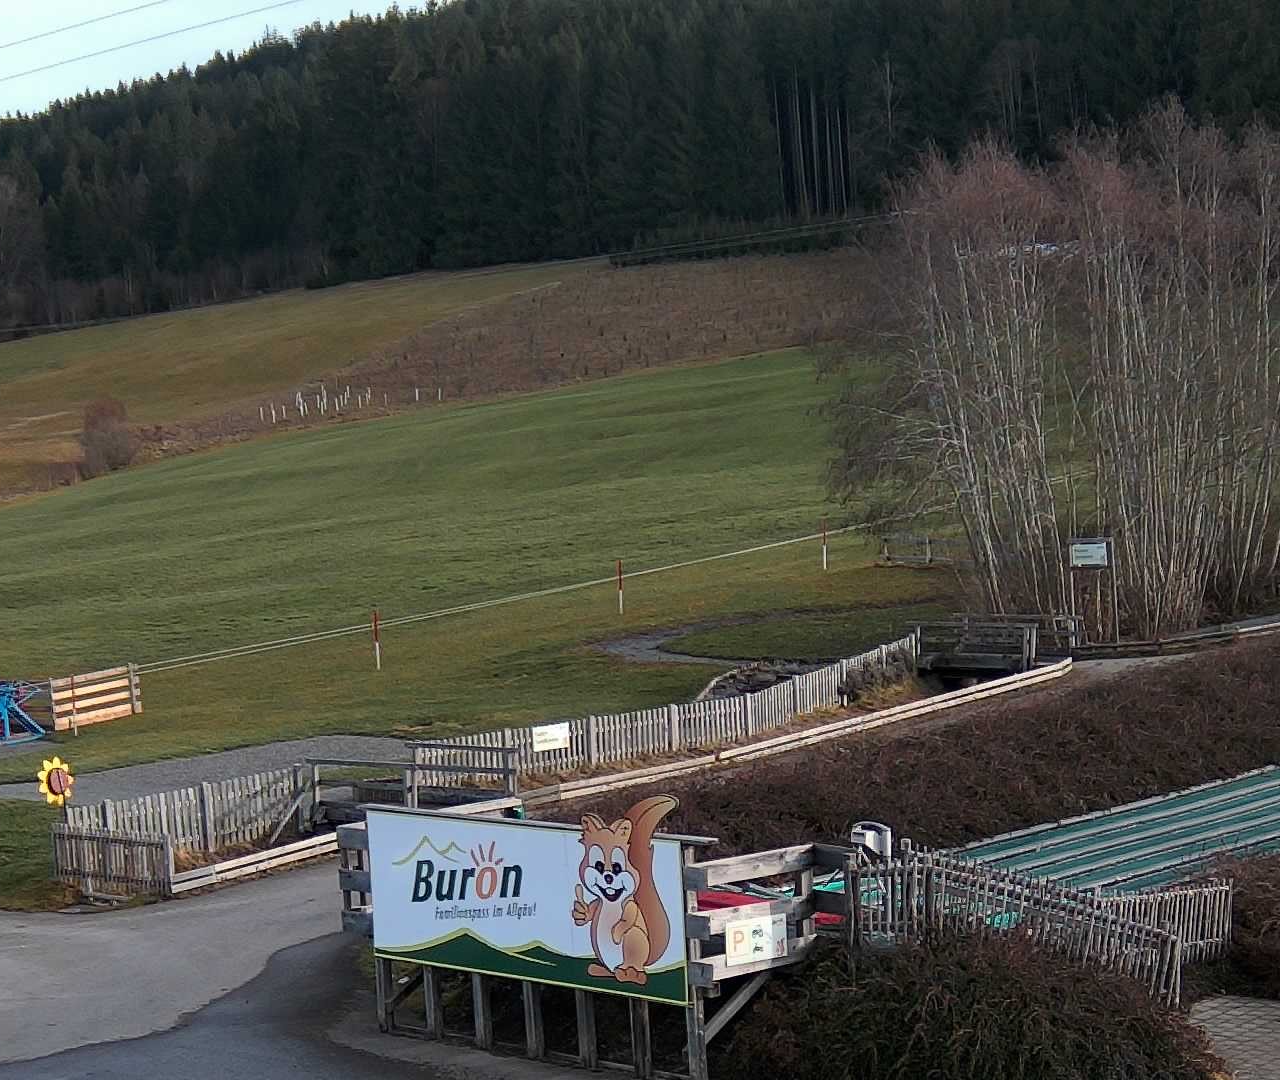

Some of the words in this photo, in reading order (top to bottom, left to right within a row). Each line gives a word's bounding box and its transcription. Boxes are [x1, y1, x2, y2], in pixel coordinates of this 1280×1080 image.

[411, 859, 523, 902] Buron
[492, 904, 504, 917] im
[506, 902, 537, 919] Allgäu!
[733, 930, 745, 953] P
